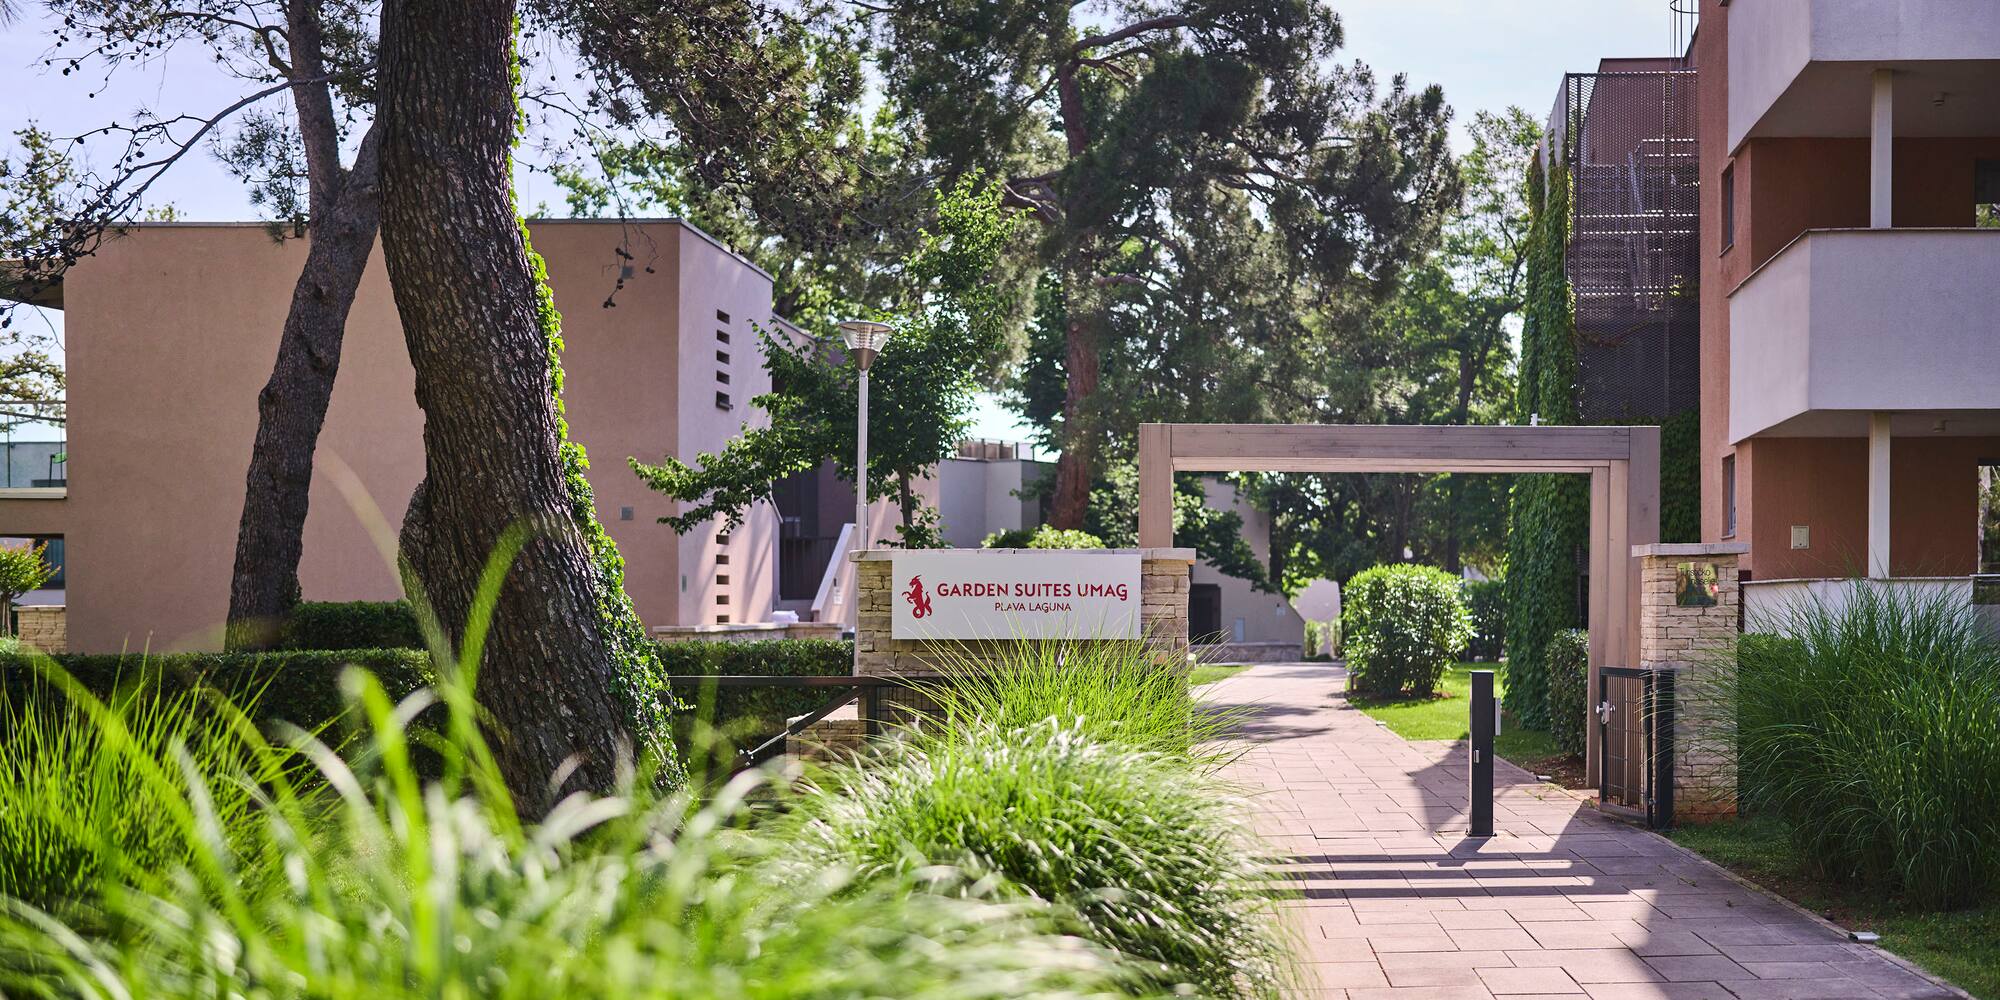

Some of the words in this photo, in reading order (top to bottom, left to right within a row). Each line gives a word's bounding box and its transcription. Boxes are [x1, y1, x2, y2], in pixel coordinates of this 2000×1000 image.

[937, 583, 1009, 597] GARDEN
[1014, 583, 1072, 597] SUITES
[1077, 583, 1128, 601] UMAG
[994, 602, 1026, 612] PLAVA
[1029, 602, 1072, 613] LAGUNA
